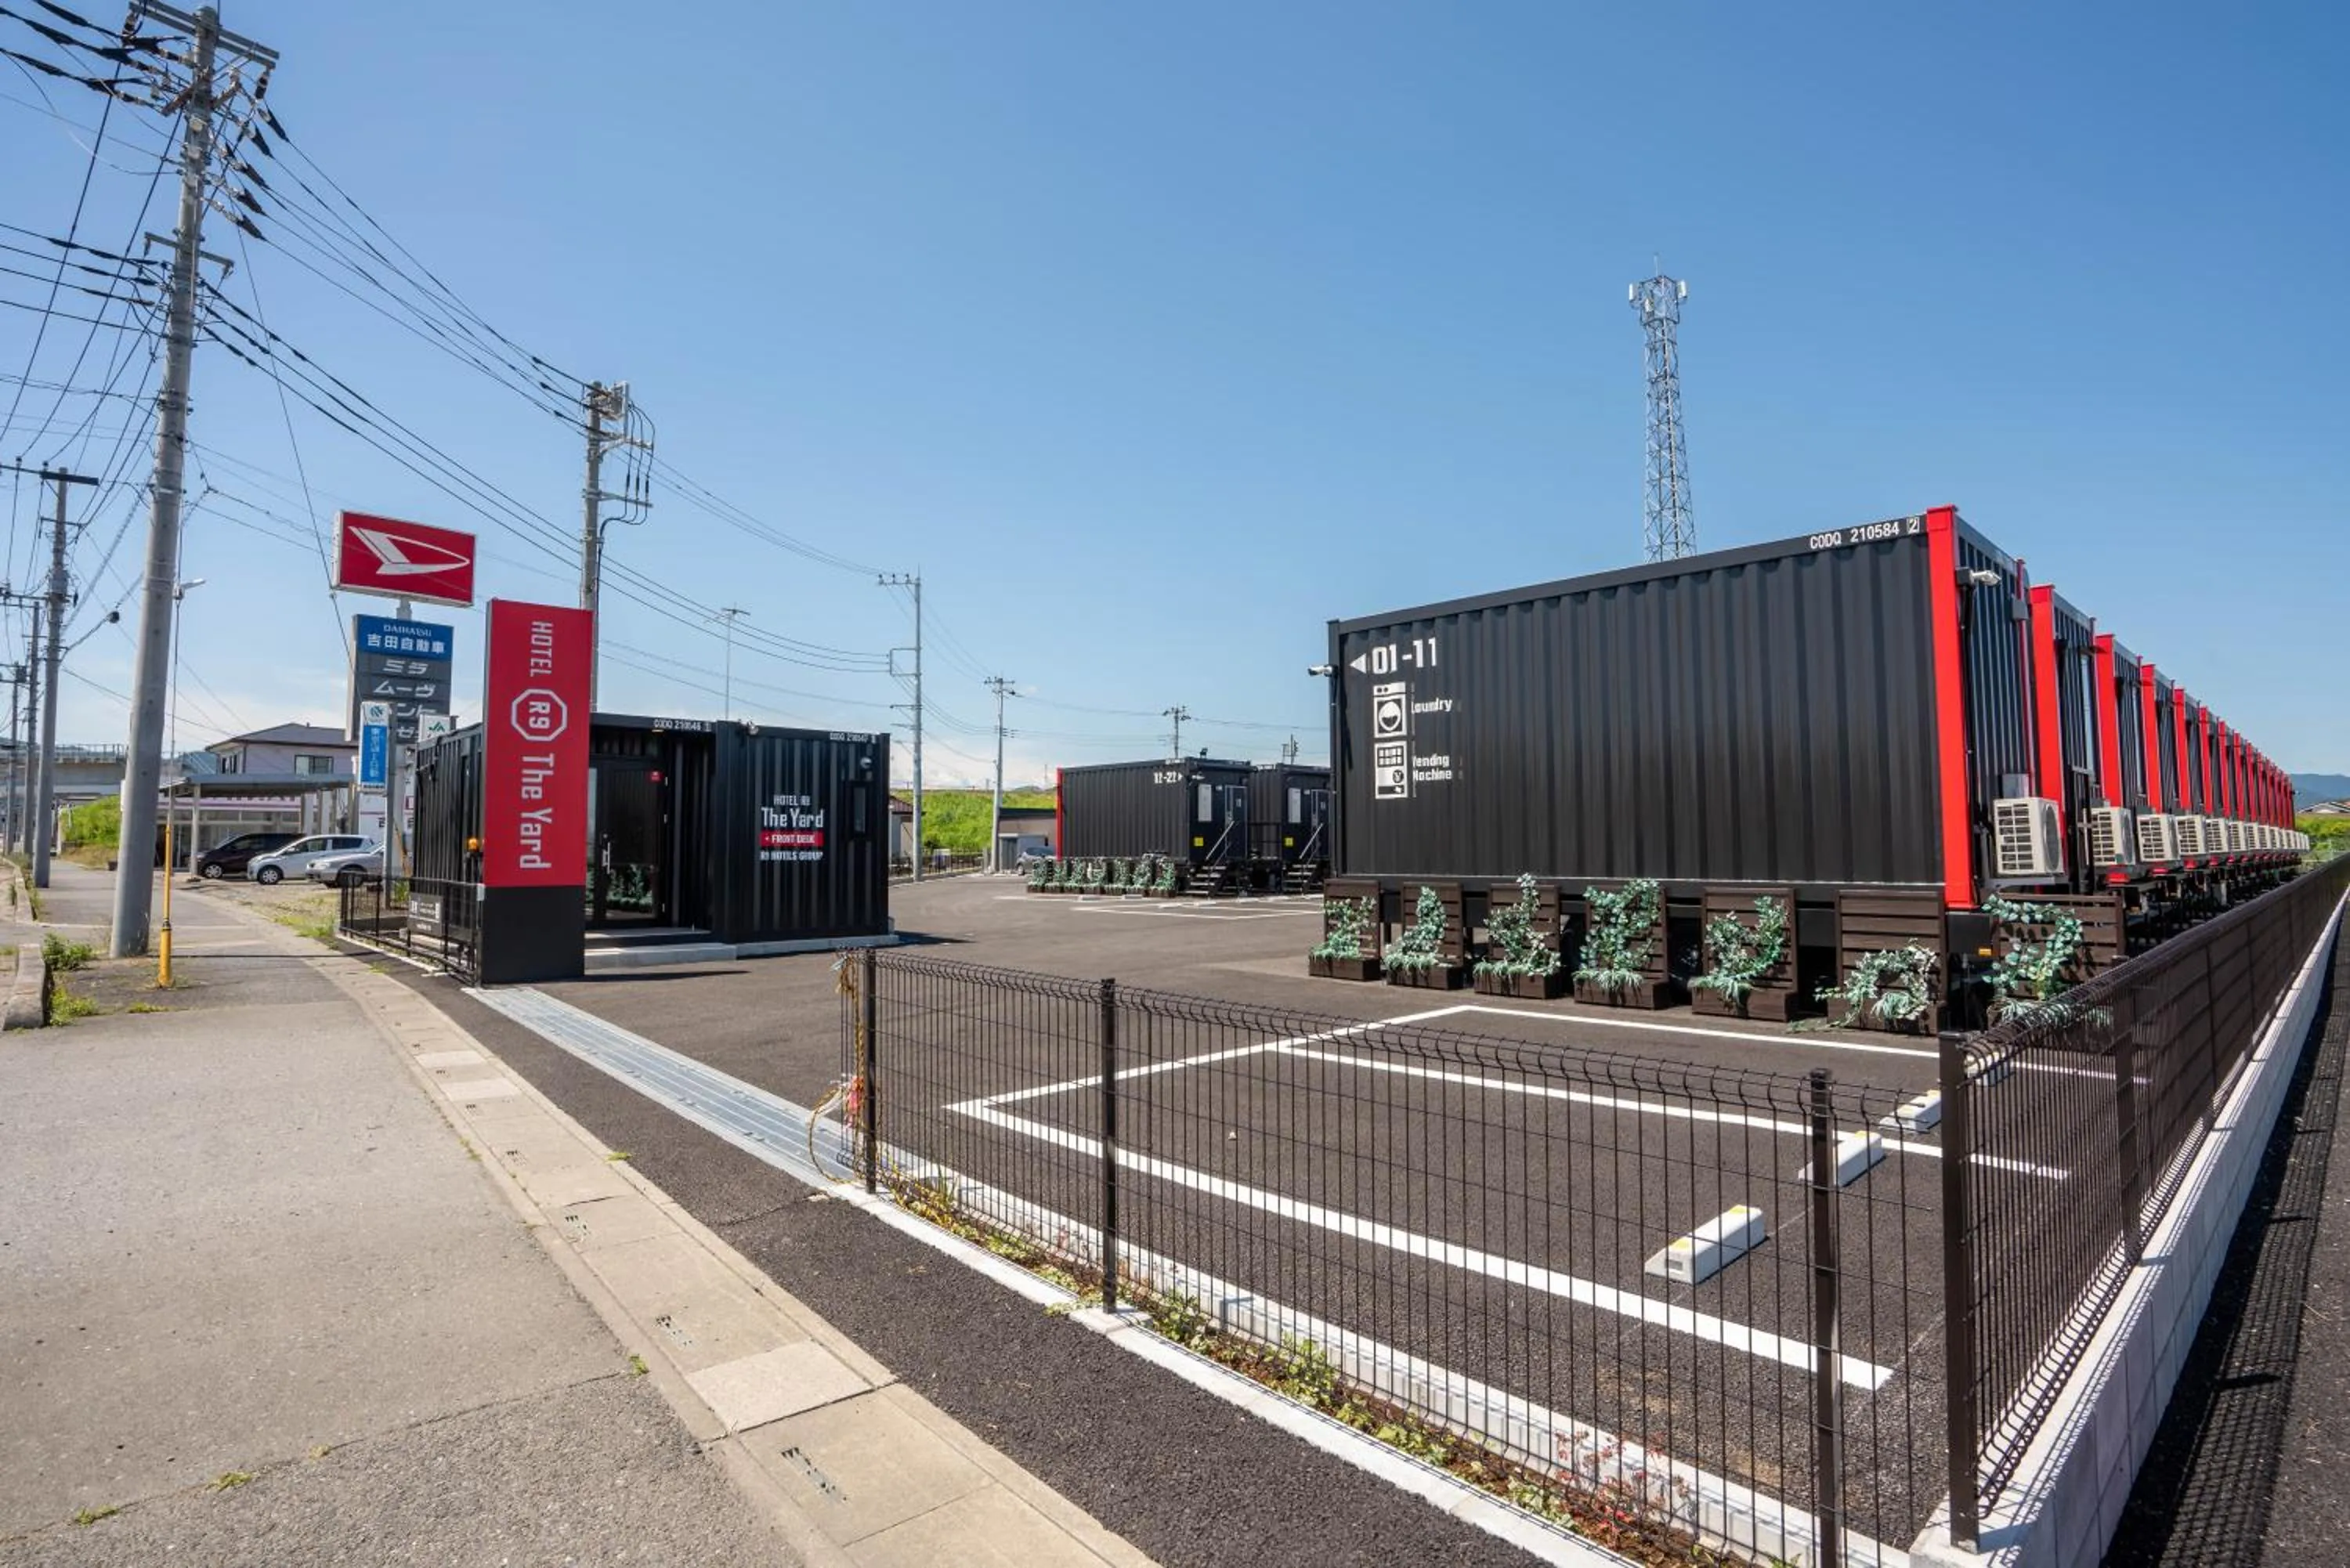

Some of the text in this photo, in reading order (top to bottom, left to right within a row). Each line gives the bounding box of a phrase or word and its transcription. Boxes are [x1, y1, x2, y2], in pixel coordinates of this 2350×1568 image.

[1849, 521, 1900, 543] 210584
[382, 659, 428, 674] ミラ
[373, 680, 436, 698] ムーヴ
[390, 703, 436, 718] ント
[520, 621, 554, 869] HOTEL R9 The Yard
[773, 794, 798, 806] HOTEL
[761, 807, 824, 828] The Yard
[772, 834, 795, 844] FRONT
